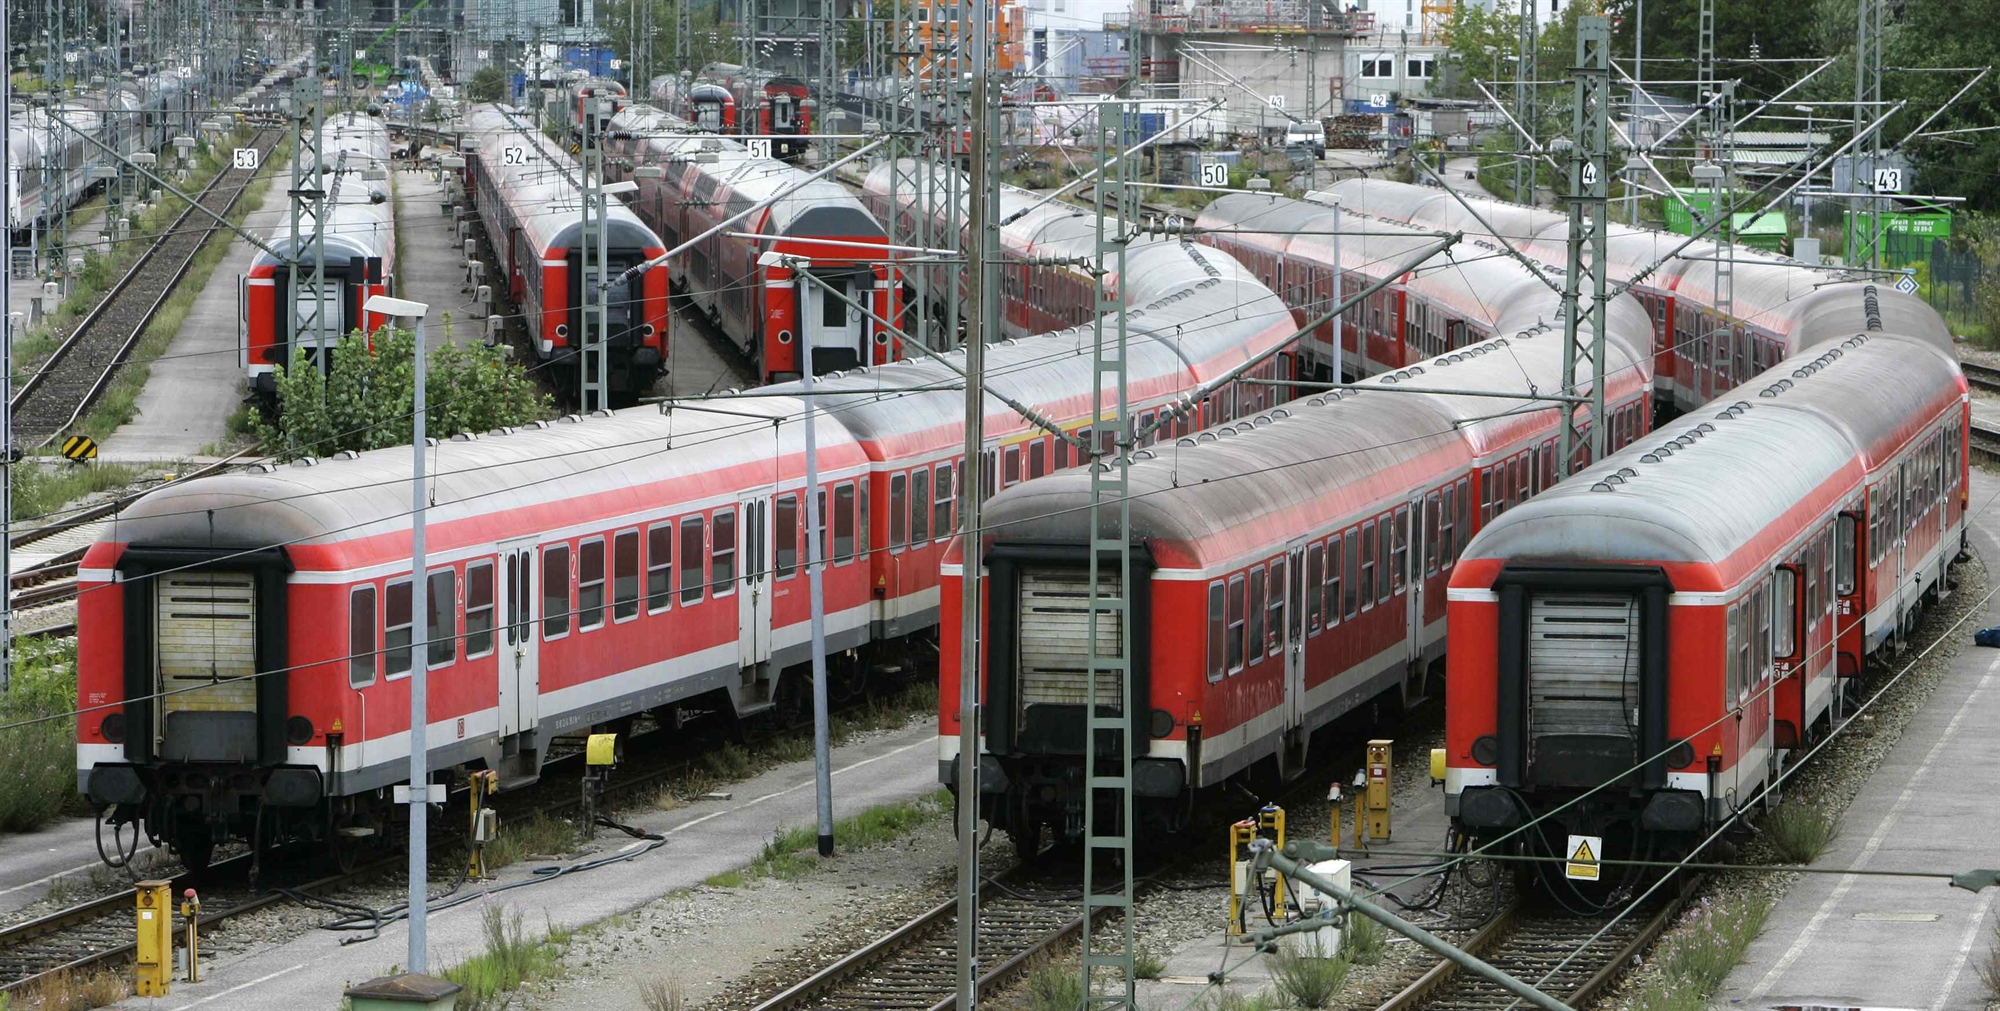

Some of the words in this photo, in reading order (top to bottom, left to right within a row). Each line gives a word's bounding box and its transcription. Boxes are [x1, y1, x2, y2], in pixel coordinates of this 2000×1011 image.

[1271, 97, 1283, 107] 43
[1373, 95, 1384, 106] 42
[237, 150, 255, 167] 53
[505, 147, 523, 164] 52
[751, 141, 767, 158] 51
[1204, 165, 1225, 184] 50
[1879, 171, 1898, 189] 43
[952, 471, 957, 499] 2
[705, 524, 710, 548] 2
[572, 553, 577, 579] 2
[458, 577, 463, 604] 2
